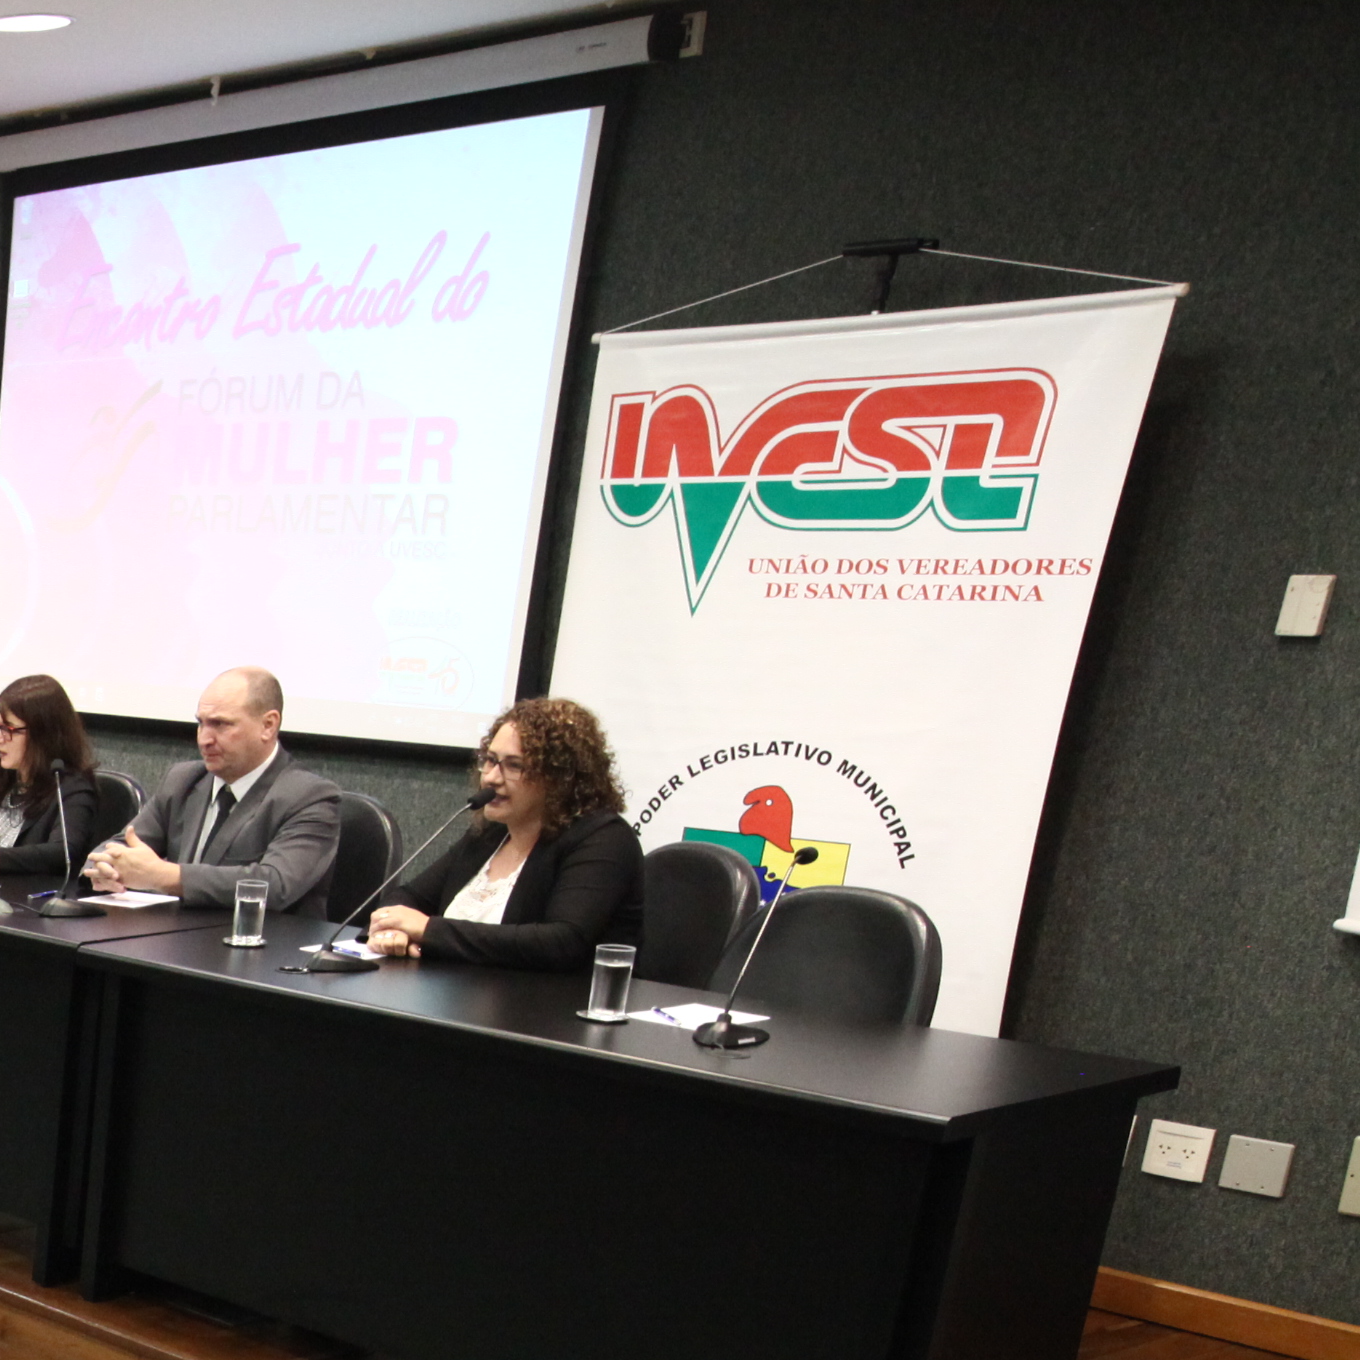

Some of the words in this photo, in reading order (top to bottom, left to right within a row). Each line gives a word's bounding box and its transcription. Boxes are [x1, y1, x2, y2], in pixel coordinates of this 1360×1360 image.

[56, 263, 220, 353] Encontro
[233, 229, 448, 340] Estadual
[431, 230, 492, 323] do
[178, 367, 305, 416] FÓRUM
[316, 369, 365, 411] DA
[172, 415, 460, 487] MULHER
[166, 493, 450, 537] PARLAMENTAR
[389, 541, 447, 560] UVESC
[747, 554, 829, 576] UNIÃO
[835, 557, 889, 576] DOS
[897, 557, 1093, 577] VEREADORES
[765, 582, 798, 601] DE
[803, 582, 890, 602] SANTA
[896, 583, 1045, 602] CATARINA
[632, 774, 685, 837] PODER
[686, 740, 833, 778] LEGISLATIVO
[835, 758, 916, 870] MUNICIPAL
